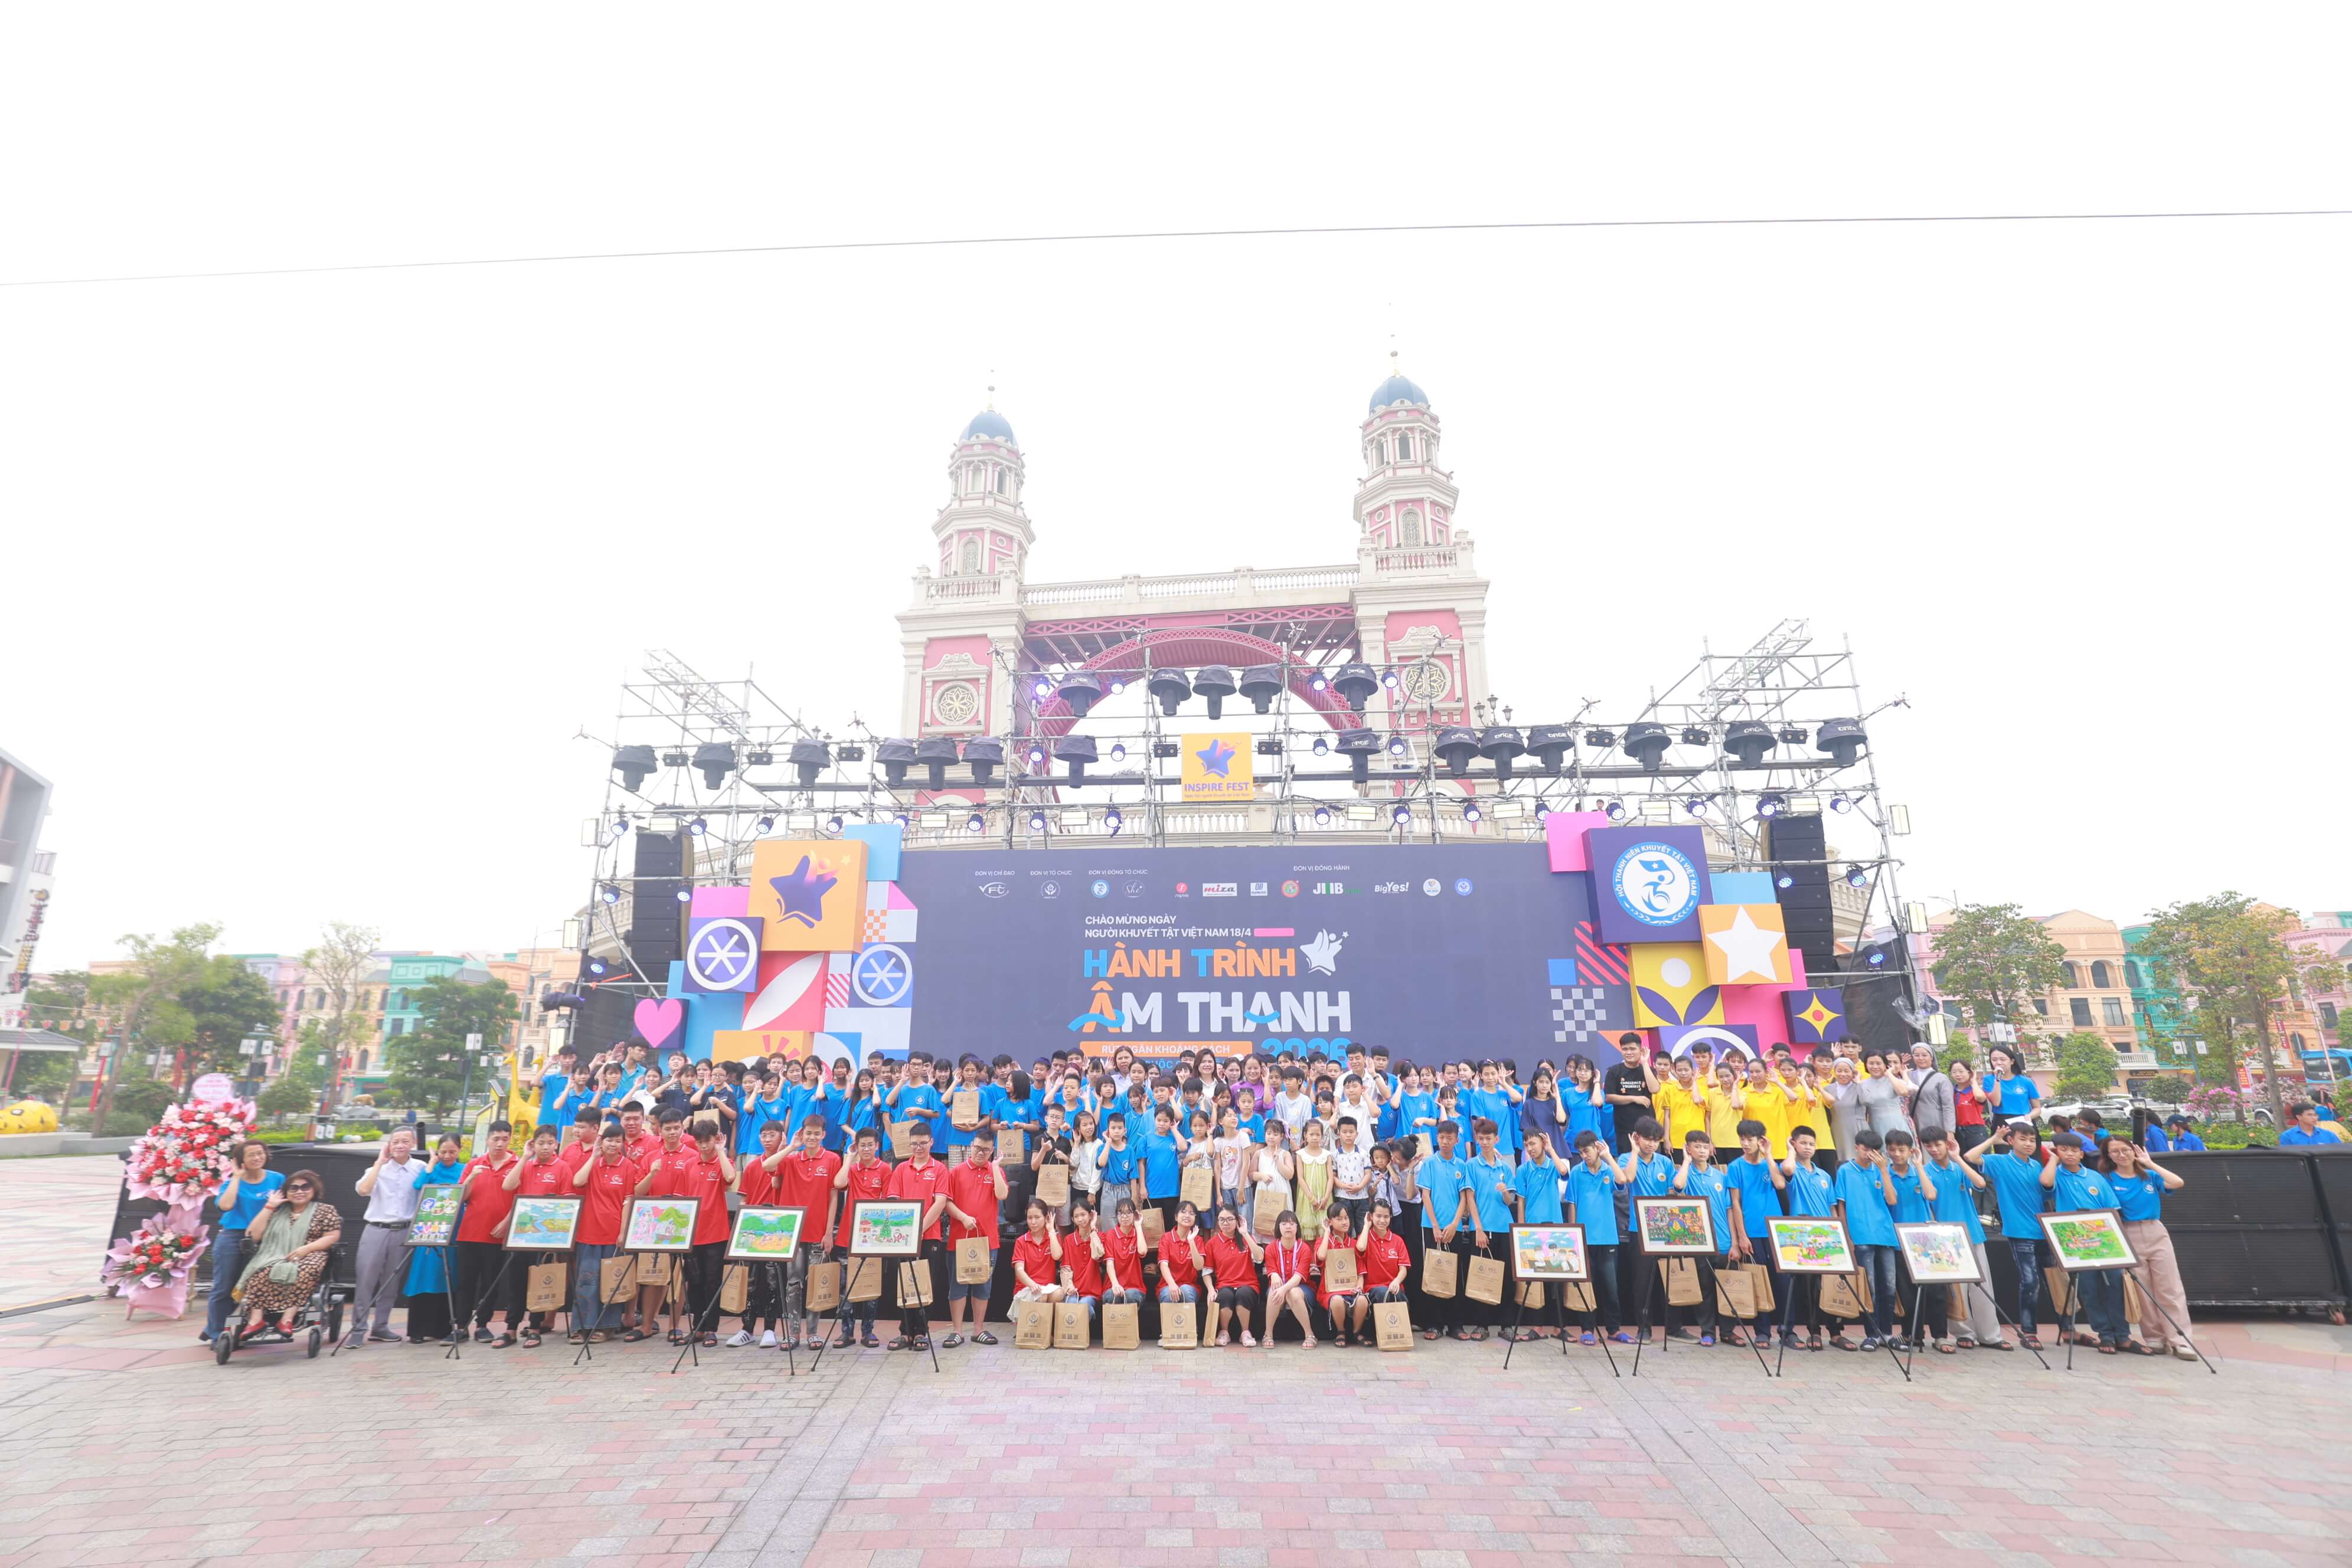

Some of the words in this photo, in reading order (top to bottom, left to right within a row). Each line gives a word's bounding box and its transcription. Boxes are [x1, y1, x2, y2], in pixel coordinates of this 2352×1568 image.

[1185, 783, 1223, 792] INSPIRE
[1227, 782, 1250, 791] FEST
[1625, 847, 1641, 861] NIÊN
[1641, 844, 1671, 854] KHUYẾT
[1671, 851, 1685, 863] TẬT
[1615, 859, 1627, 883] THANH
[1684, 863, 1696, 878] VIỆT
[1374, 881, 1409, 894] BigYes!
[1615, 884, 1625, 897] HỘI
[1086, 913, 1114, 925] CHÀO
[1116, 914, 1147, 924] MỪNG
[1149, 913, 1176, 924] NGÀY
[1085, 927, 1118, 937] NGƯỜI
[1119, 926, 1159, 937] KHUYẾT
[1161, 926, 1179, 939] TẬT
[1181, 926, 1203, 939] VIỆT
[1205, 928, 1229, 937] NAM
[1230, 927, 1252, 937] 18/4
[1084, 942, 1180, 978] HÀNH
[1191, 940, 1295, 977] TRÌNH
[1083, 981, 1162, 1033] ÂM
[1178, 991, 1352, 1033] THANH
[1261, 1037, 1351, 1069] 2026
